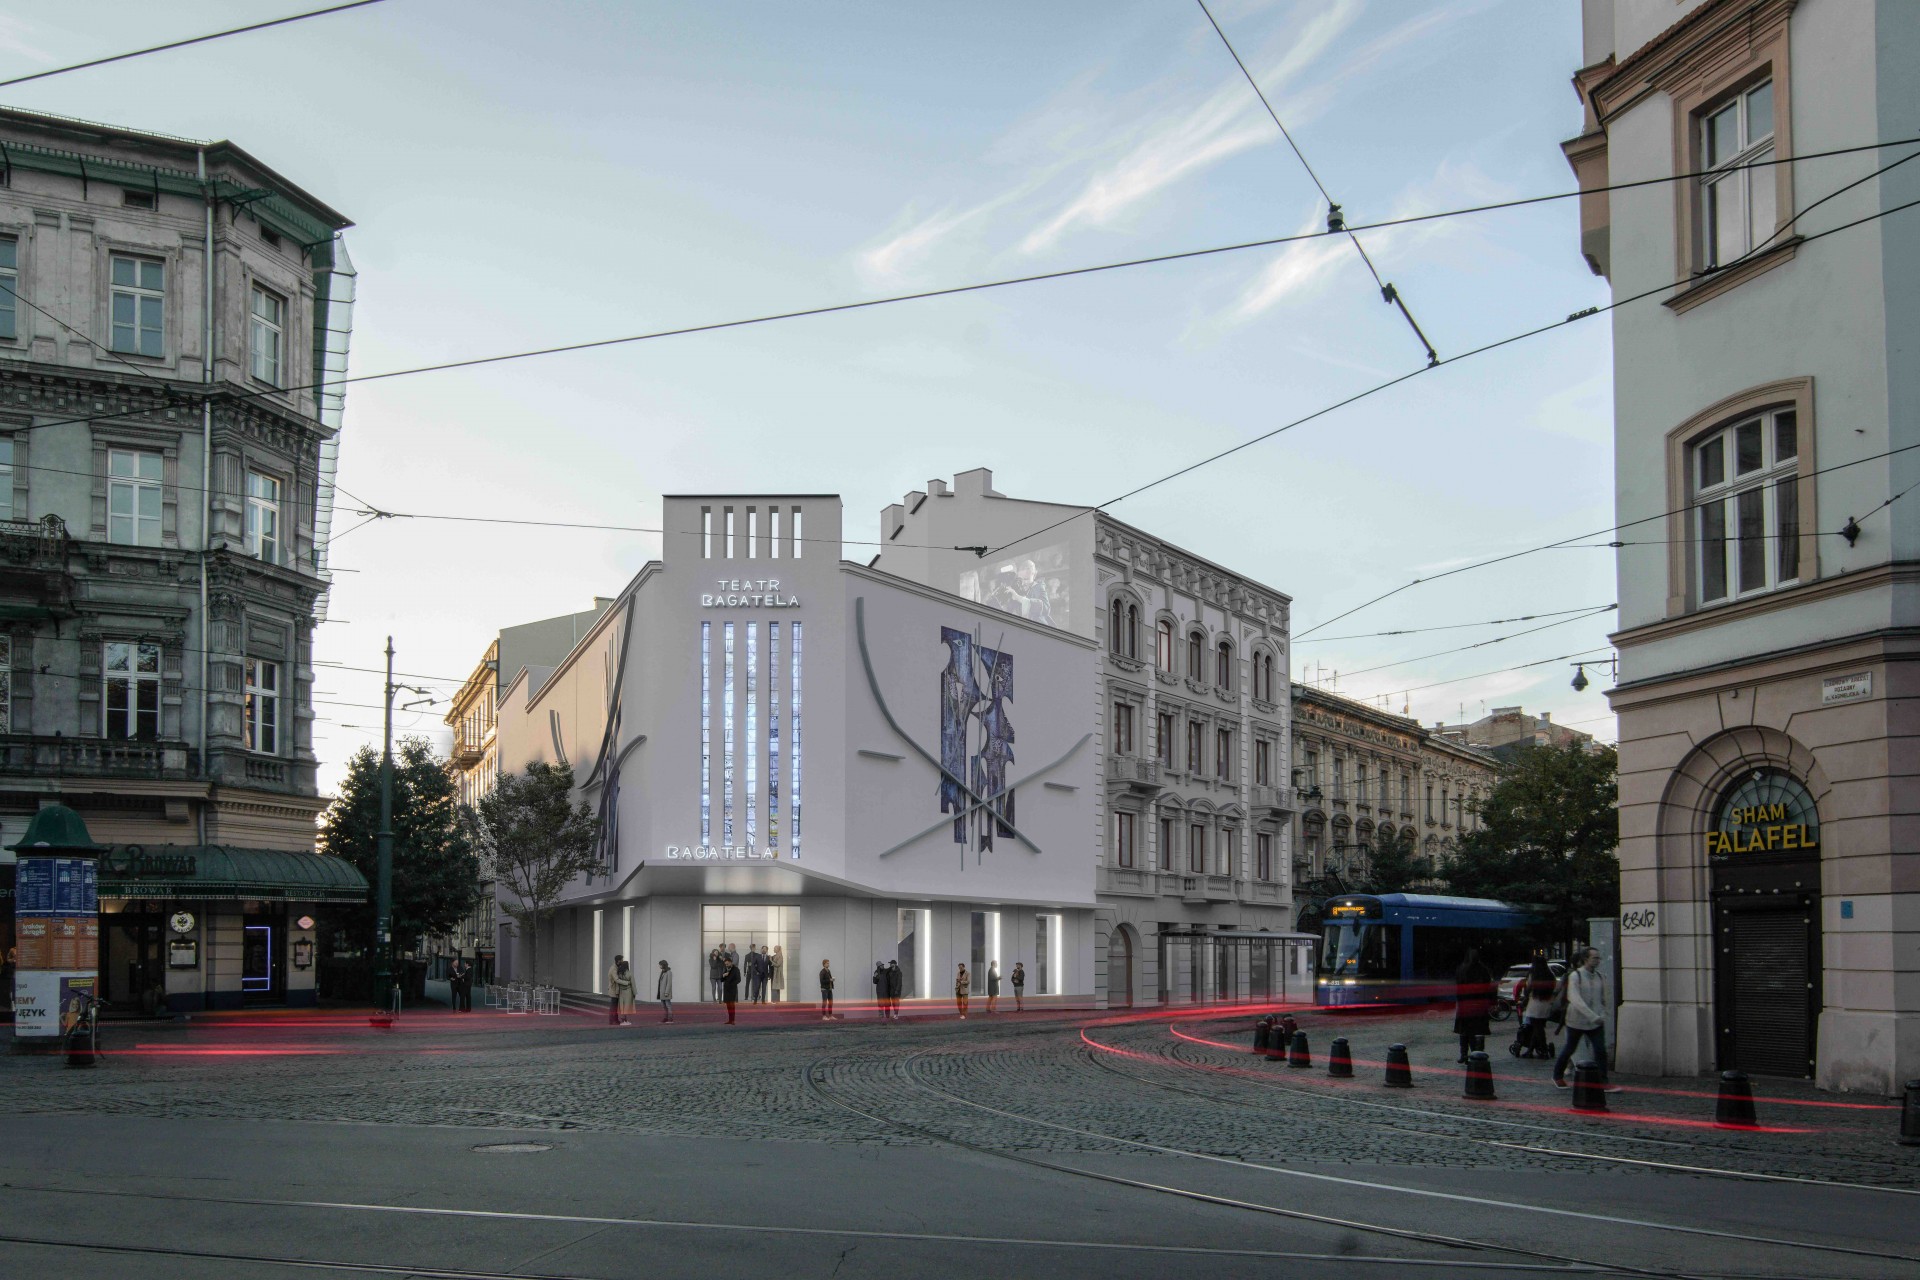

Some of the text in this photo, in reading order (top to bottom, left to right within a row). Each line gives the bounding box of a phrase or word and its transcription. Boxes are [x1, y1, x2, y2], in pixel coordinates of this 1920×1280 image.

[717, 579, 780, 591] TEATR
[702, 594, 800, 607] BAGATELA
[1731, 802, 1786, 826] SHAM
[1705, 823, 1816, 855] FALAFEL
[667, 846, 774, 859] BAGATELA
[124, 886, 173, 895] BROWAR
[18, 1008, 46, 1019] JĘZYK
